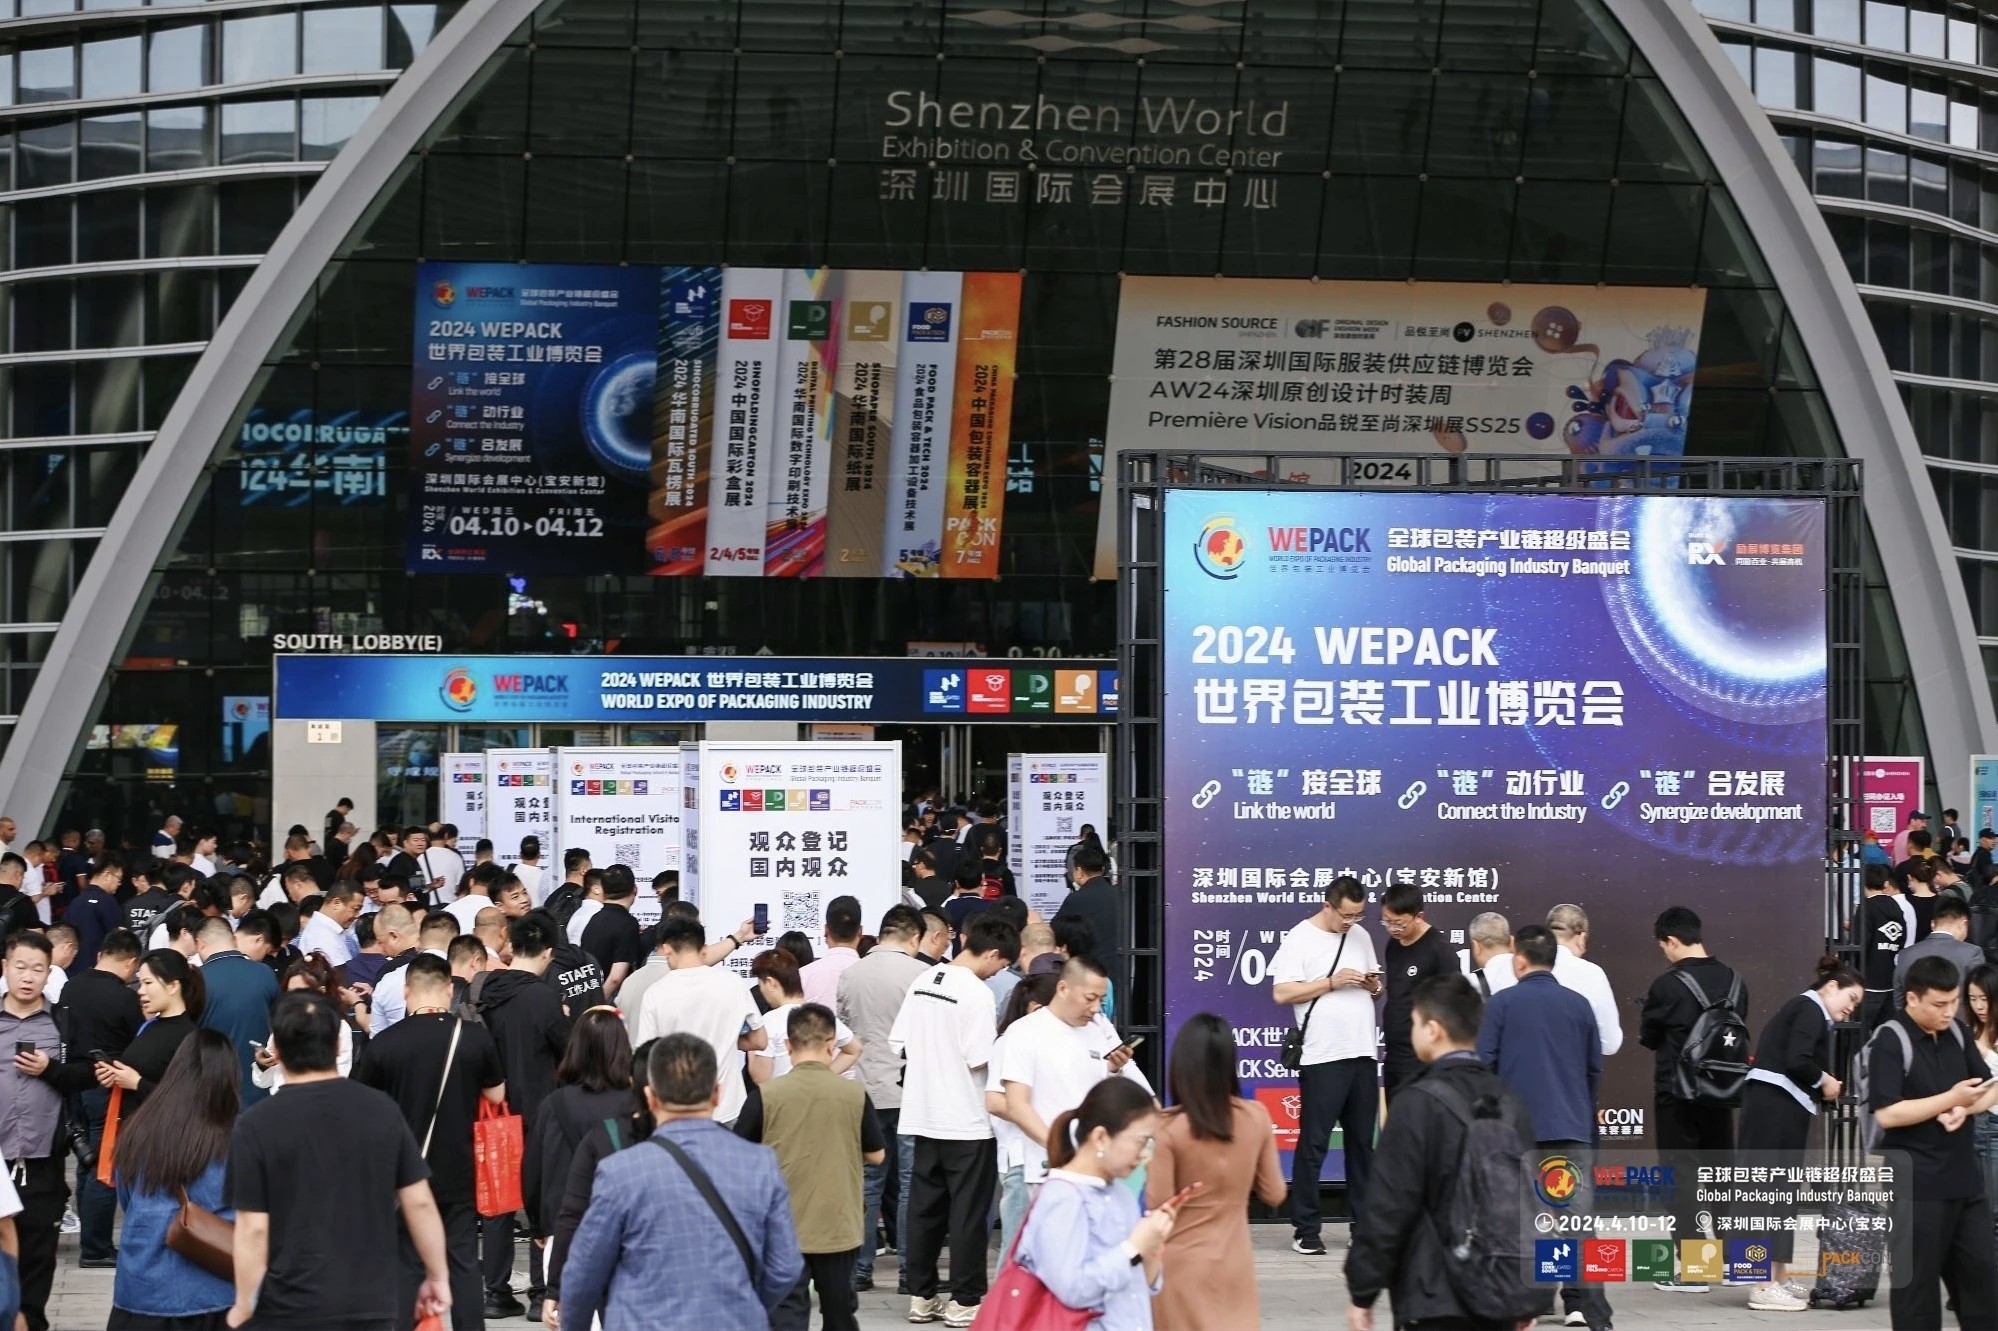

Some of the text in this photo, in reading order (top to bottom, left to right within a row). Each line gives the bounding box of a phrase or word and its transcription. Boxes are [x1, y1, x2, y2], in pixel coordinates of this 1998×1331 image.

[885, 90, 1289, 138] Shenzhen World
[883, 135, 1284, 168] Exhibition & Convention Center
[880, 168, 1278, 209] 深圳国际会展中心
[466, 287, 515, 299] WEPACK
[429, 320, 562, 338] 2024 WEPACK
[1156, 316, 1278, 330] FASHION SOURCE
[427, 343, 603, 363] 世界包装工业博览会
[1154, 347, 1534, 377] 第28届深圳国际服装供应链博览会
[484, 372, 525, 385] 接全球
[673, 359, 688, 388] 2024
[854, 362, 867, 391] 2024
[927, 364, 937, 393] FOOD
[1150, 379, 1452, 405] AW24深圳原创设计时装周
[483, 405, 524, 419] 动行业
[925, 397, 934, 423] PACK
[1148, 410, 1248, 429] Première
[727, 360, 747, 506] 2024 中国国际彩盒展
[745, 360, 761, 507] SINOFOLDINGCARTON 2024
[965, 364, 988, 510] 2024 中国包装容器展
[481, 438, 522, 452] 合发展
[922, 437, 932, 462] TECH
[920, 465, 929, 491] 2024
[450, 516, 520, 536] 04.10
[535, 517, 603, 537] 04.12
[1267, 526, 1372, 553] WEPACK
[1387, 527, 1631, 551] 全球包装产业链超级盛会
[710, 547, 746, 561] 2/4/5
[1387, 556, 1631, 578] Global Packaging Industry Banquet
[272, 633, 443, 652] SOUTH LOBBY(E)
[1192, 624, 1499, 666] 2024 WEPACK
[493, 674, 569, 693] WEPACK
[601, 672, 874, 689] 2024 WEPACK 世界包装工业博览会
[602, 693, 874, 710] WORLD EXPO OF PACKAGING INDUSTRY
[1193, 678, 1625, 727] 世界包装工业博览会
[745, 765, 782, 774] WEPACK
[1302, 768, 1383, 796] 接全球
[1505, 769, 1585, 796] 动行业
[1707, 769, 1786, 796] 合发展
[570, 813, 645, 824] International
[1233, 801, 1336, 820] Link the world
[1437, 802, 1588, 824] Connect the Industry
[1639, 801, 1803, 824] Synergize development
[594, 825, 665, 837] Registration
[749, 831, 848, 852] 观众登记
[749, 856, 849, 878] 国内观众
[1191, 891, 1254, 904] Shenzhen
[1257, 891, 1295, 904] World
[1456, 892, 1499, 904] Center
[1193, 930, 1214, 982] 2024
[1215, 930, 1231, 959] 时间
[558, 963, 596, 986] STAFF
